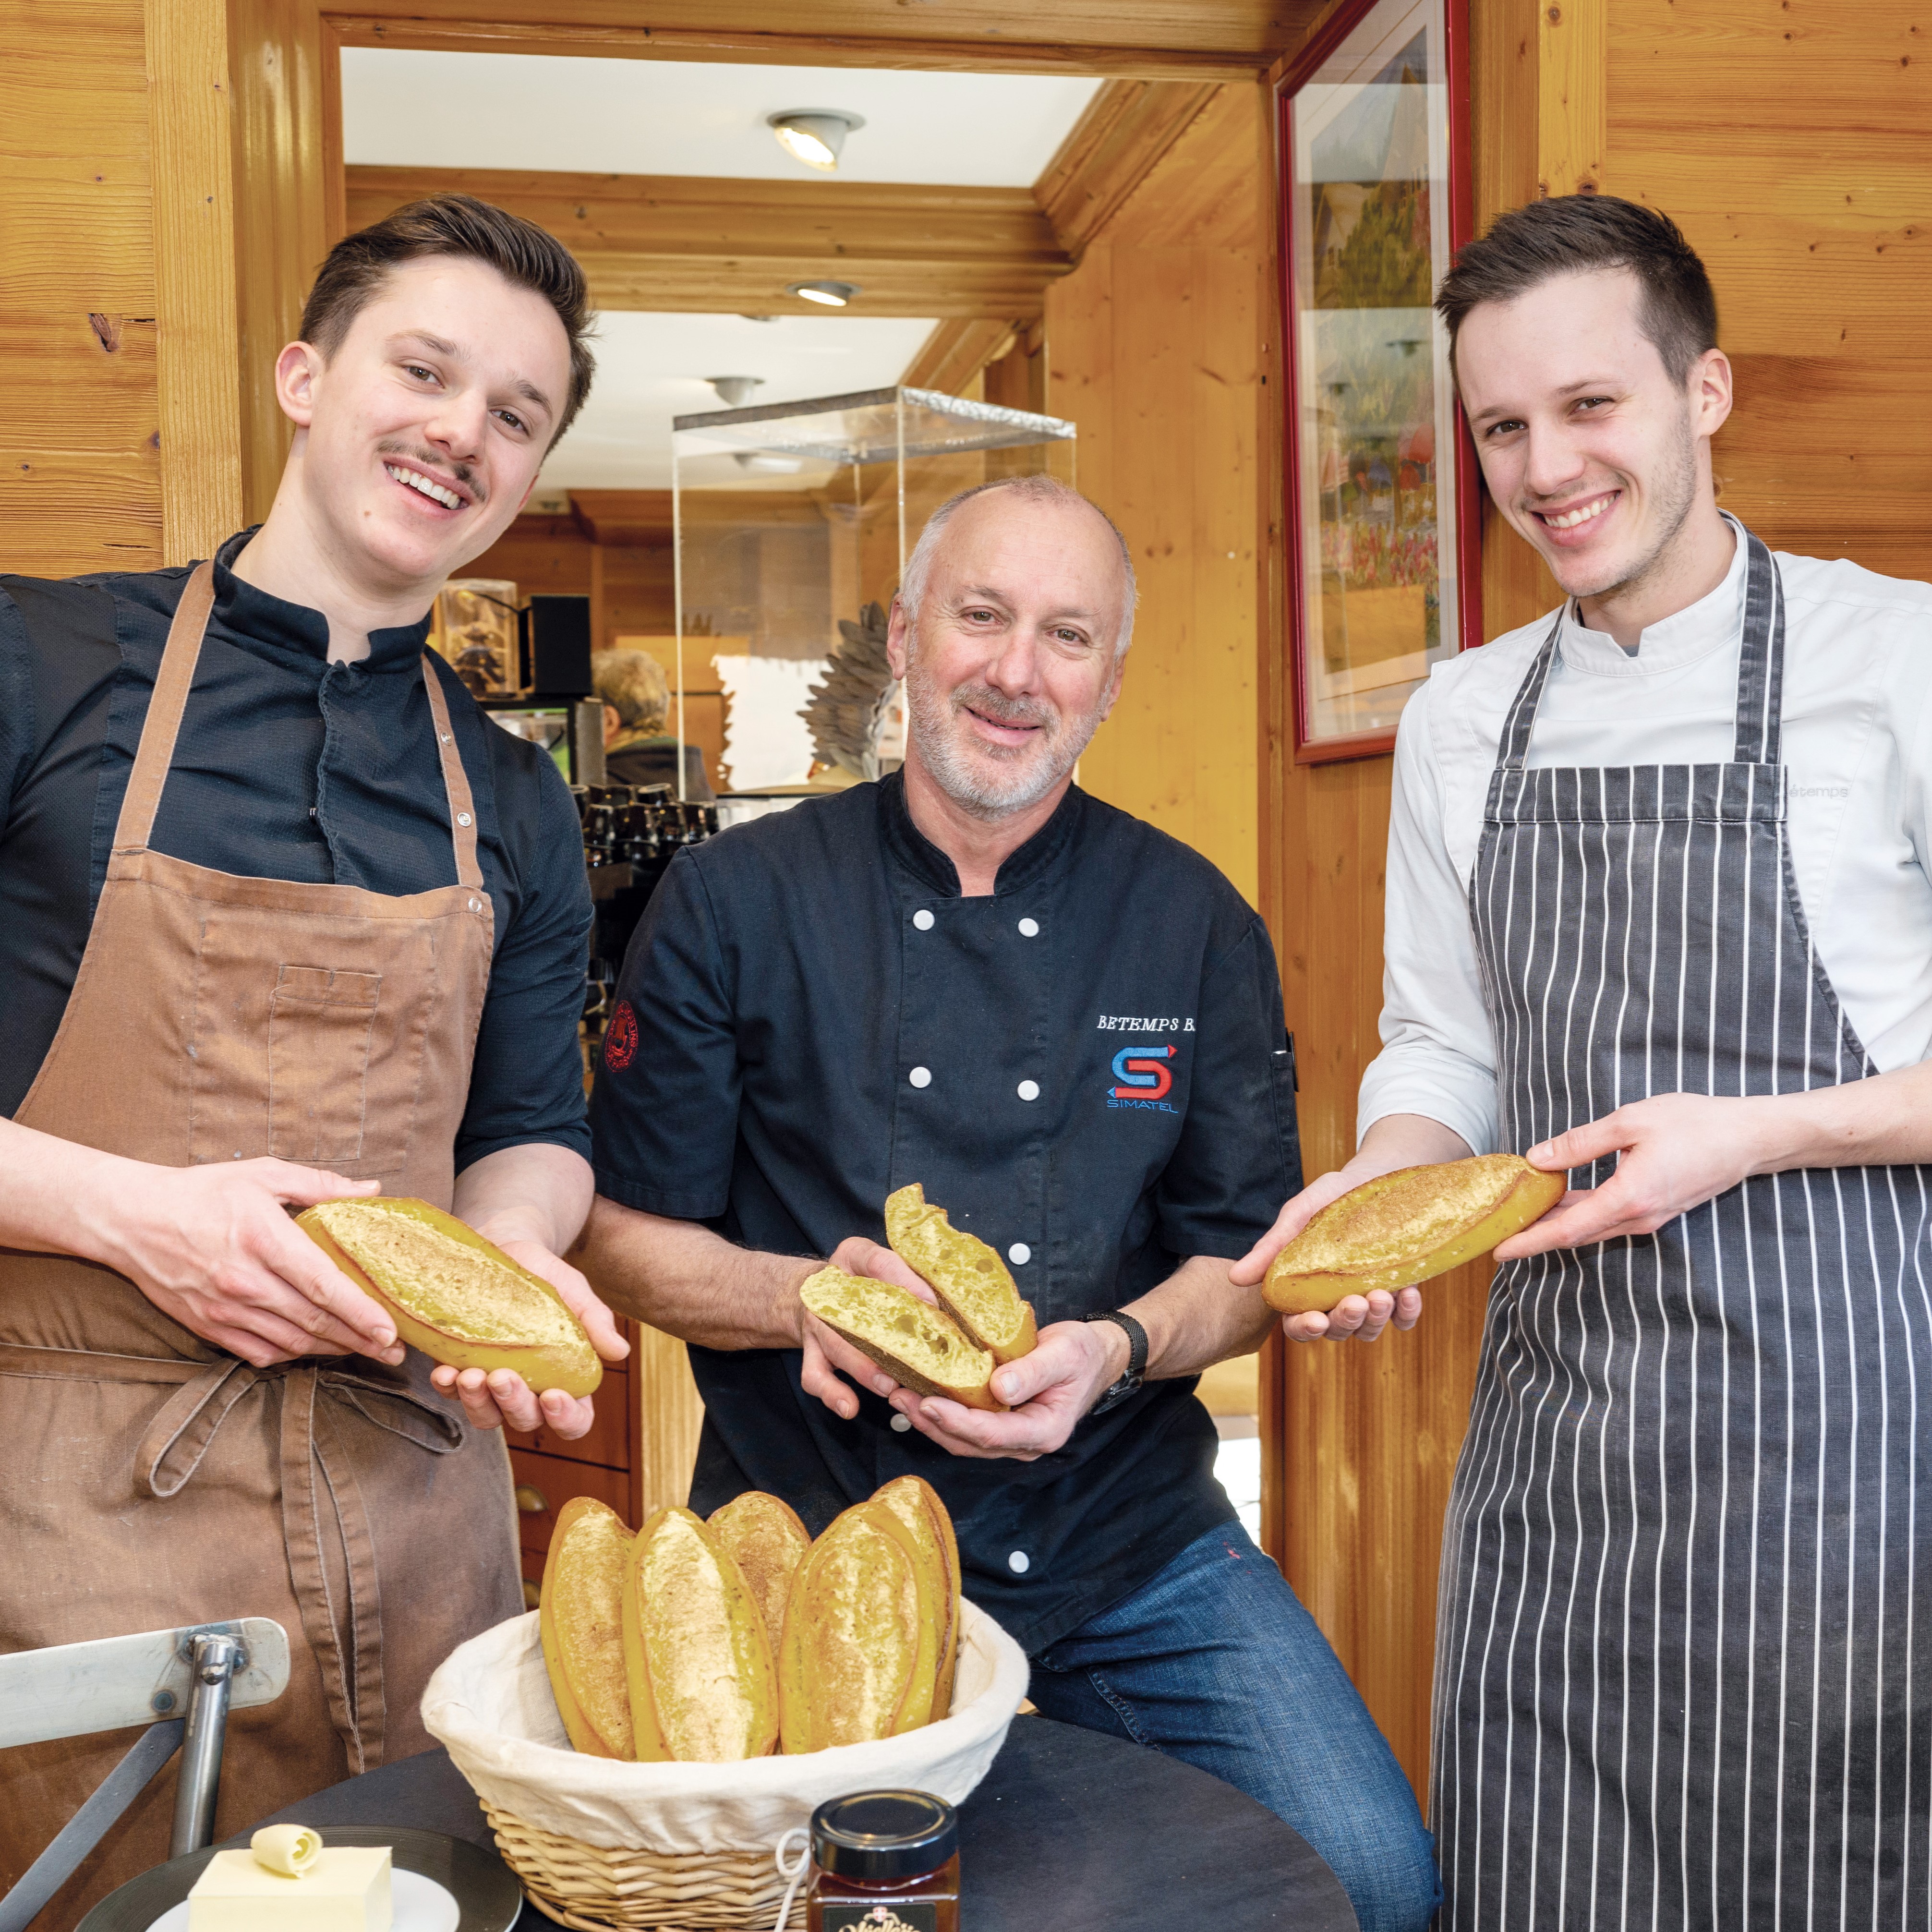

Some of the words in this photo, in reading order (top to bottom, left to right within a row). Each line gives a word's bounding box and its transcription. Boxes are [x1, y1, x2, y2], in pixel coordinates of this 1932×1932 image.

[1788, 784, 1848, 799] étemps
[1097, 1015, 1179, 1031] BETEMPS
[1107, 1099, 1178, 1113] SIMATEL
